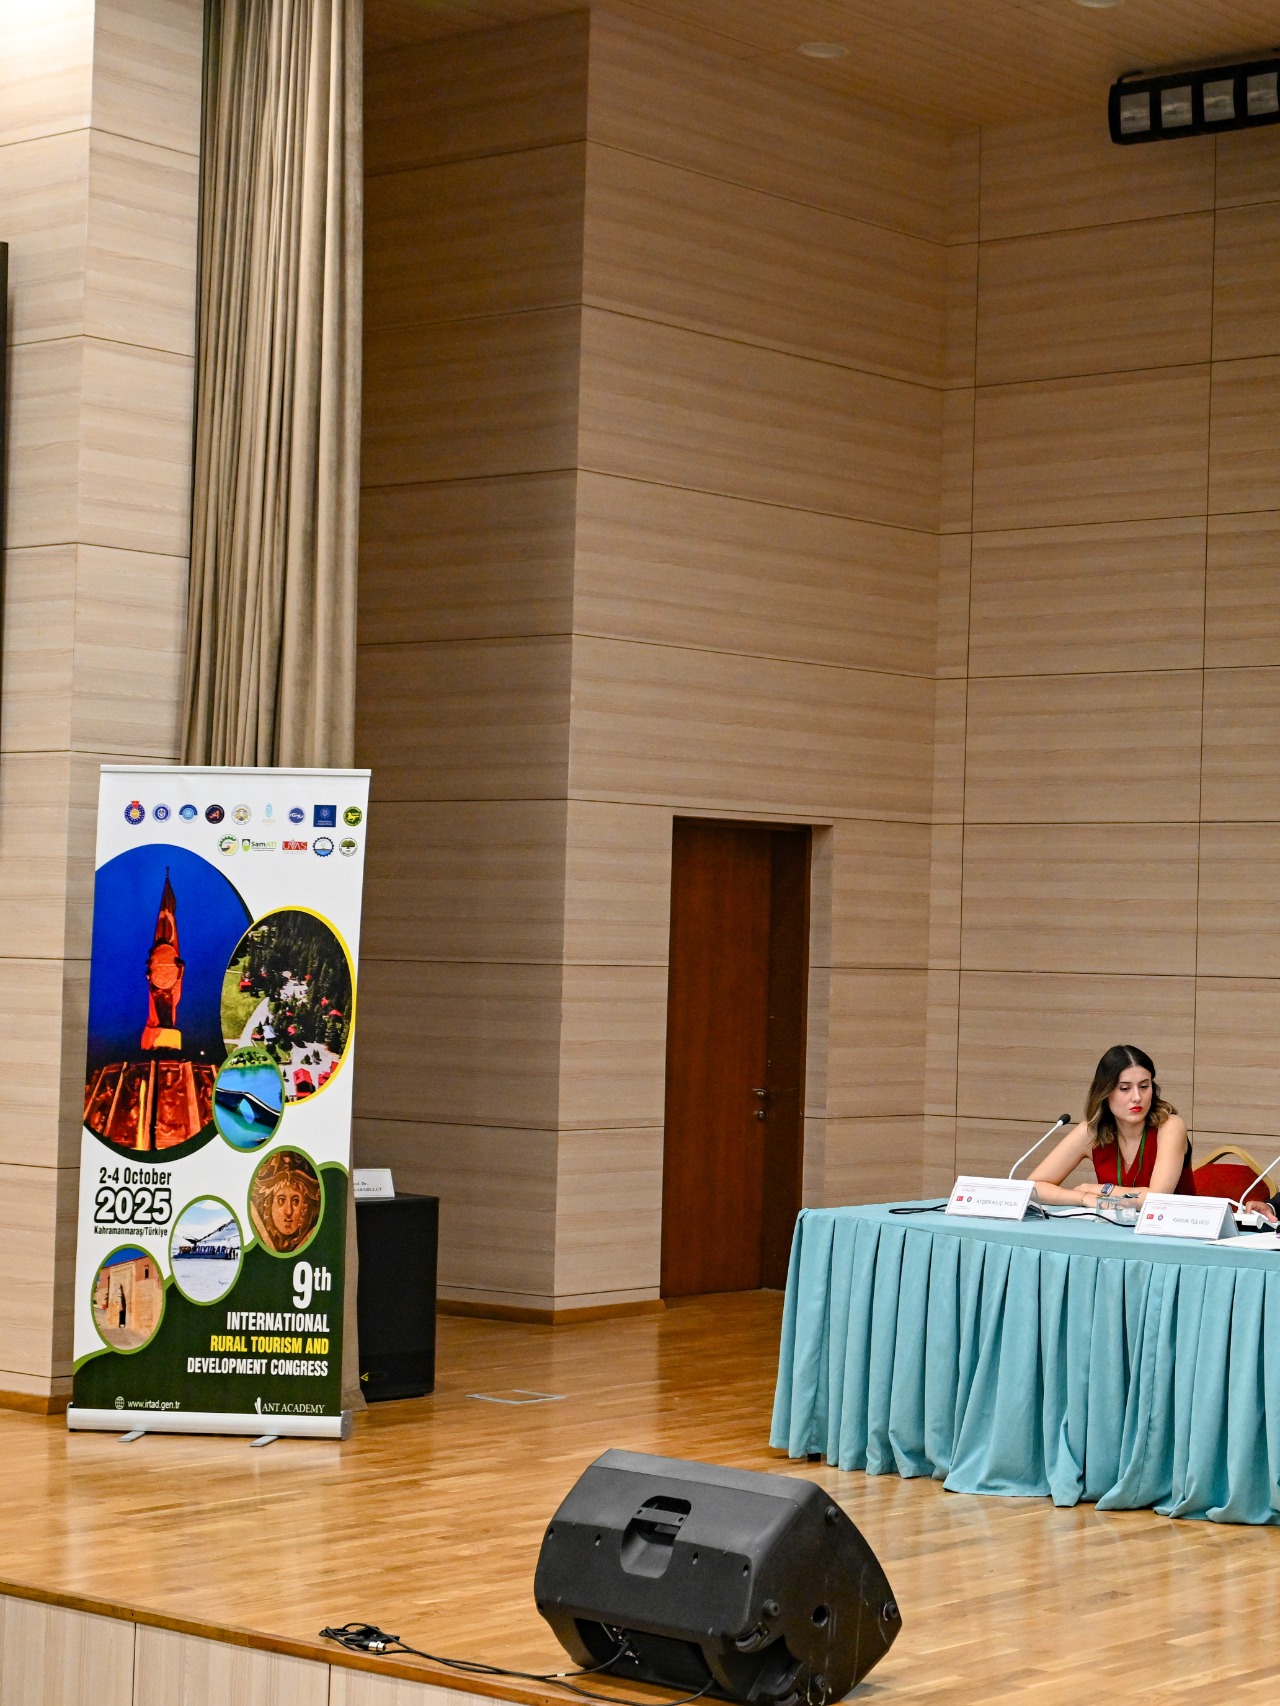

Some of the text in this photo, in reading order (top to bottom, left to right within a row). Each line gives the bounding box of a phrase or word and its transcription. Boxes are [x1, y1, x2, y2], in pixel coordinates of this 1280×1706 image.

[99, 1167, 171, 1186] 2-4 October
[94, 1186, 172, 1225] 2025
[94, 1225, 168, 1237] Kahramanmaraş/Türkiye
[292, 1261, 331, 1309] 9th
[226, 1311, 330, 1333] INTERNATIONAL
[210, 1335, 329, 1355] RURAL TOURISM AND
[187, 1357, 329, 1377] DEVELOPMENT CONGRESS
[127, 1399, 180, 1411] www.irtad.gen.tr
[262, 1402, 325, 1414] ANT ACADEMY
